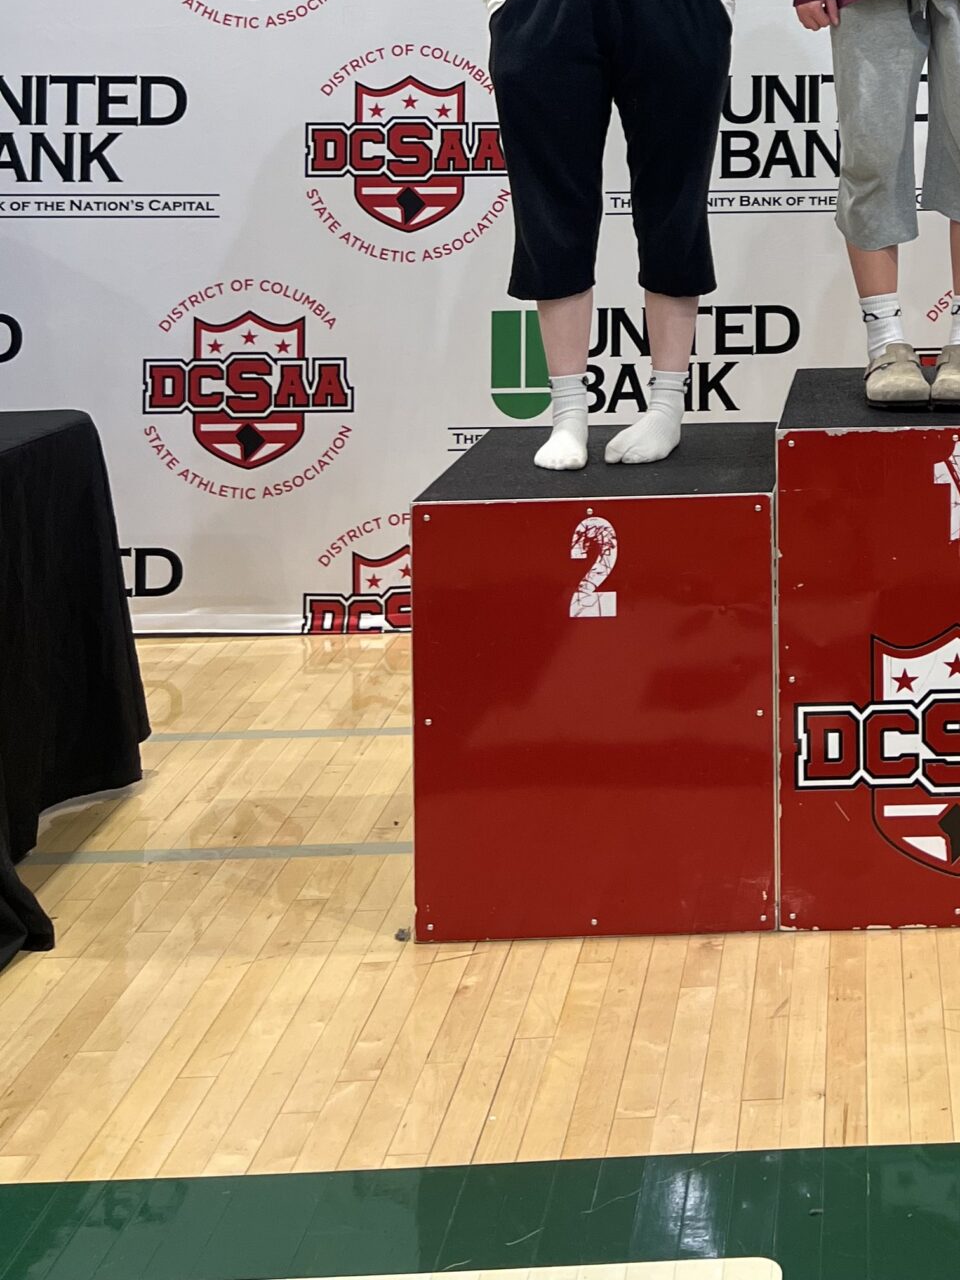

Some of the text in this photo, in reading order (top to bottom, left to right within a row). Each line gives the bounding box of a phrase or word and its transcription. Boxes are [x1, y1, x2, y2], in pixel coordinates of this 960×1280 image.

[319, 43, 496, 97] DISTRICT OF COLUMBIA
[305, 116, 508, 182] DCSAA
[306, 188, 511, 264] STATE ATHLETIC ASSOCIATION
[159, 279, 337, 334] DISTRICT OF COLUMBIA
[143, 352, 354, 418] DCSAA
[144, 424, 353, 500] STATE ATHLETIC ASSOCIATION
[319, 514, 411, 567] DISTRICT OF
[569, 516, 618, 618] 2
